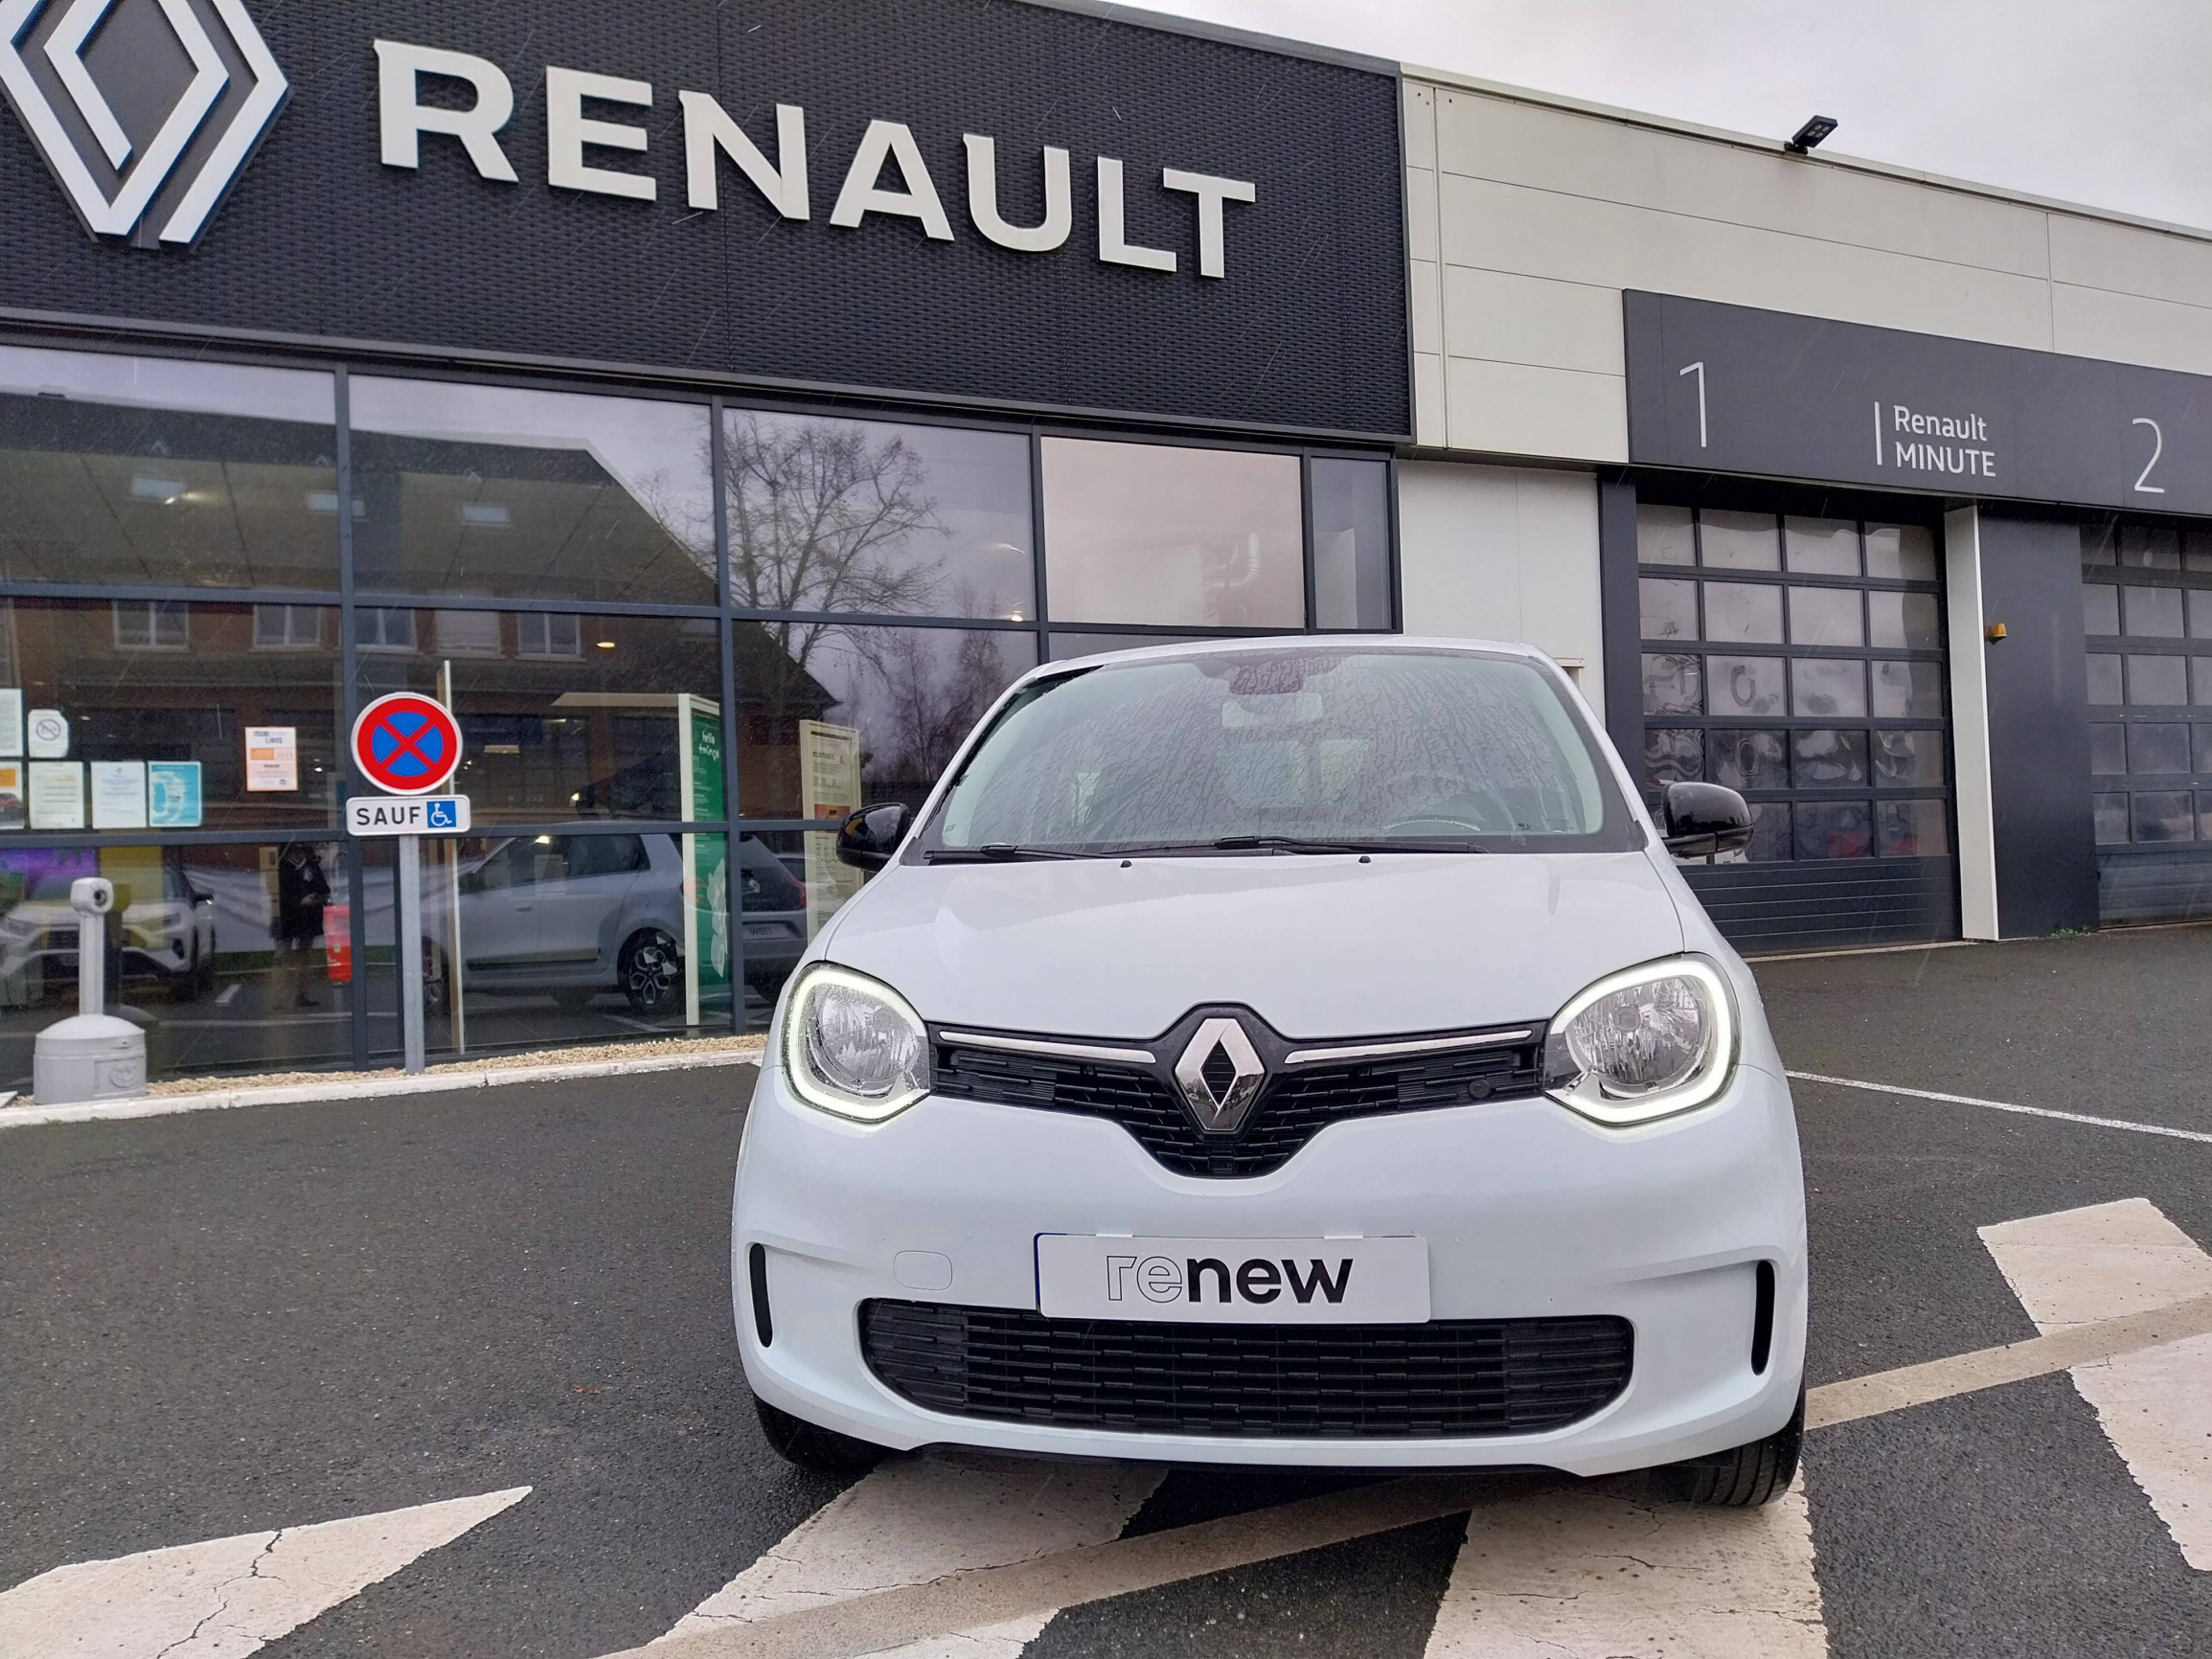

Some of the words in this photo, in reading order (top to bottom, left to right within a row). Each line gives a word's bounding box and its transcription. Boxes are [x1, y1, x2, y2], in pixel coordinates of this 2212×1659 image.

[373, 38, 1257, 280] RENAULT
[1679, 361, 1708, 448] 1
[1894, 404, 1988, 442] Renault
[1895, 441, 1996, 477] MINUTE
[2132, 417, 2166, 494] 2
[355, 806, 422, 827] SAUF
[1106, 1255, 1355, 1305] renew
